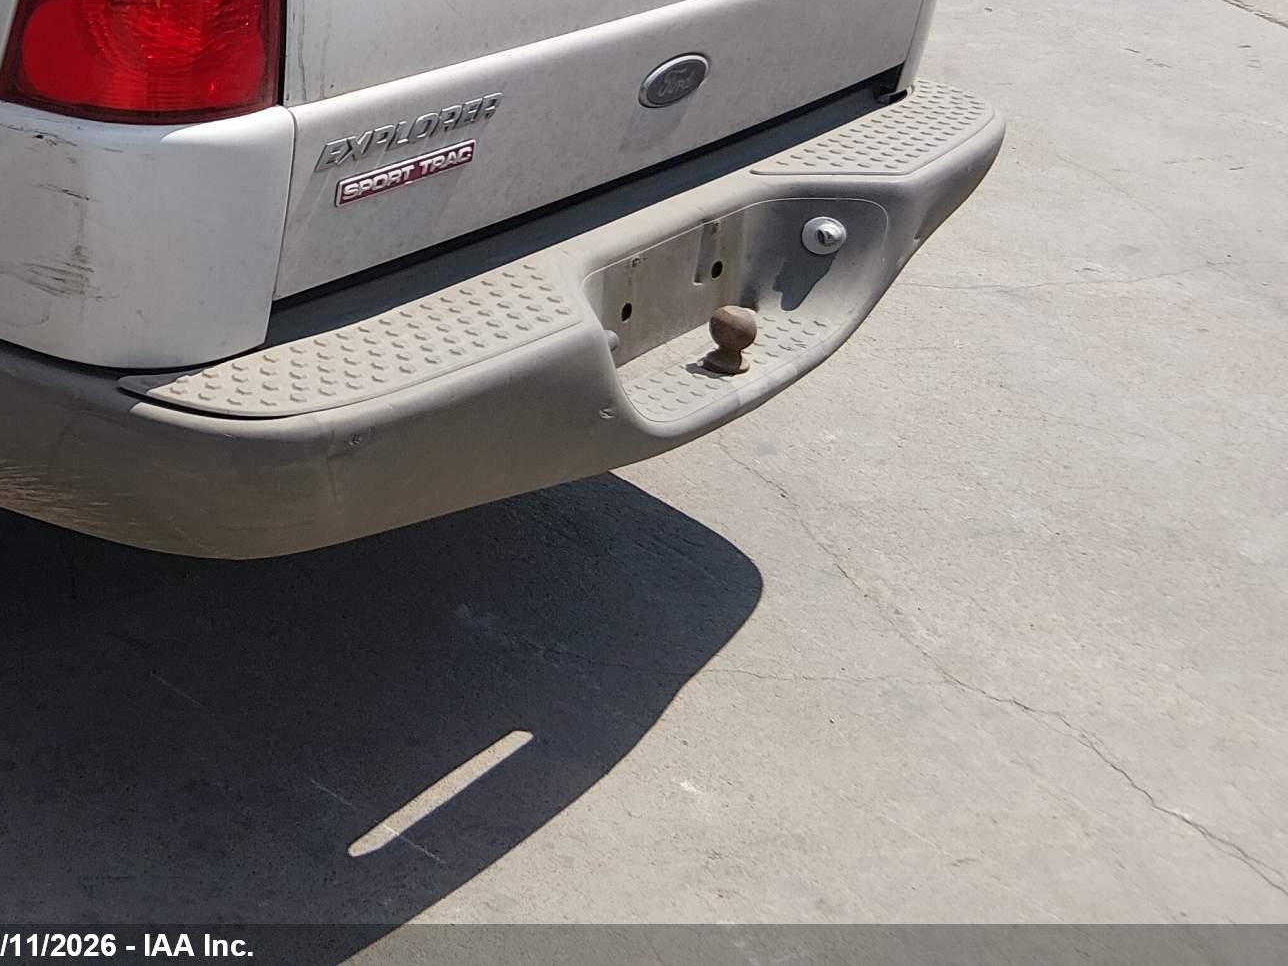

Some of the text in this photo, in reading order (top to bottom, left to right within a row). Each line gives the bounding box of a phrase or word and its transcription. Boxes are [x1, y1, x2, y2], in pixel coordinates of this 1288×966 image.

[313, 92, 504, 173] EXPLORER
[341, 146, 473, 201] SPORT TRAC
